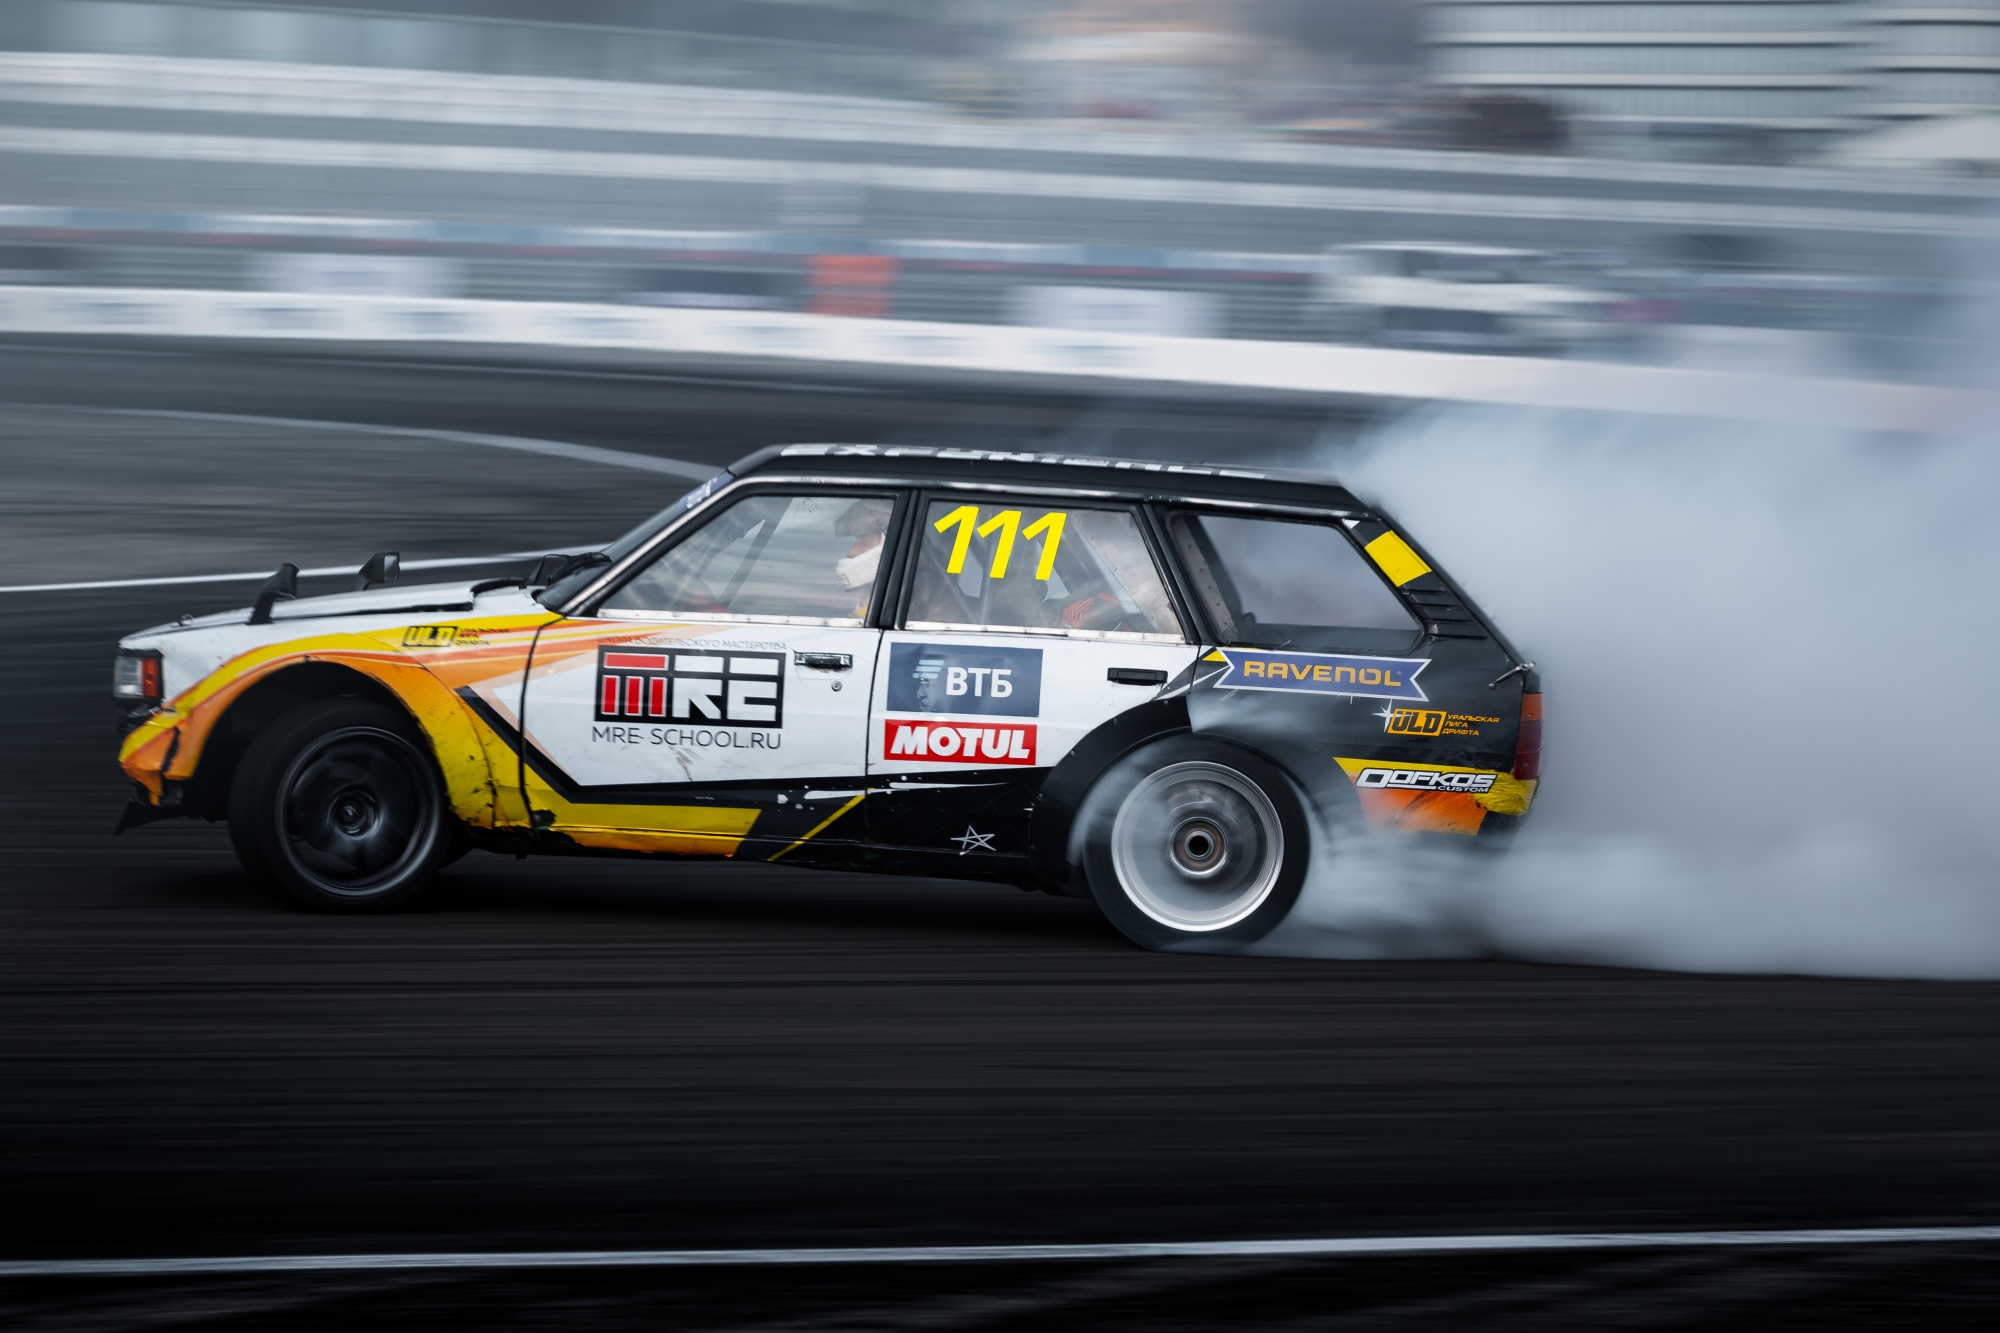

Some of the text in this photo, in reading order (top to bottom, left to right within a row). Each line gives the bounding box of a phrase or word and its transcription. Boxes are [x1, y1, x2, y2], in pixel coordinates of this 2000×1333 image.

[933, 505, 1067, 581] 111
[946, 666, 1013, 697] ВТБ
[1390, 709, 1444, 735] ULD
[1444, 721, 1469, 729] ЛИГА
[1447, 713, 1500, 724] УРАЛЬСКАЯ
[1441, 728, 1480, 737] ДРИФТА
[890, 725, 1030, 759] MOTUL
[1437, 785, 1490, 794] CUSTOM
